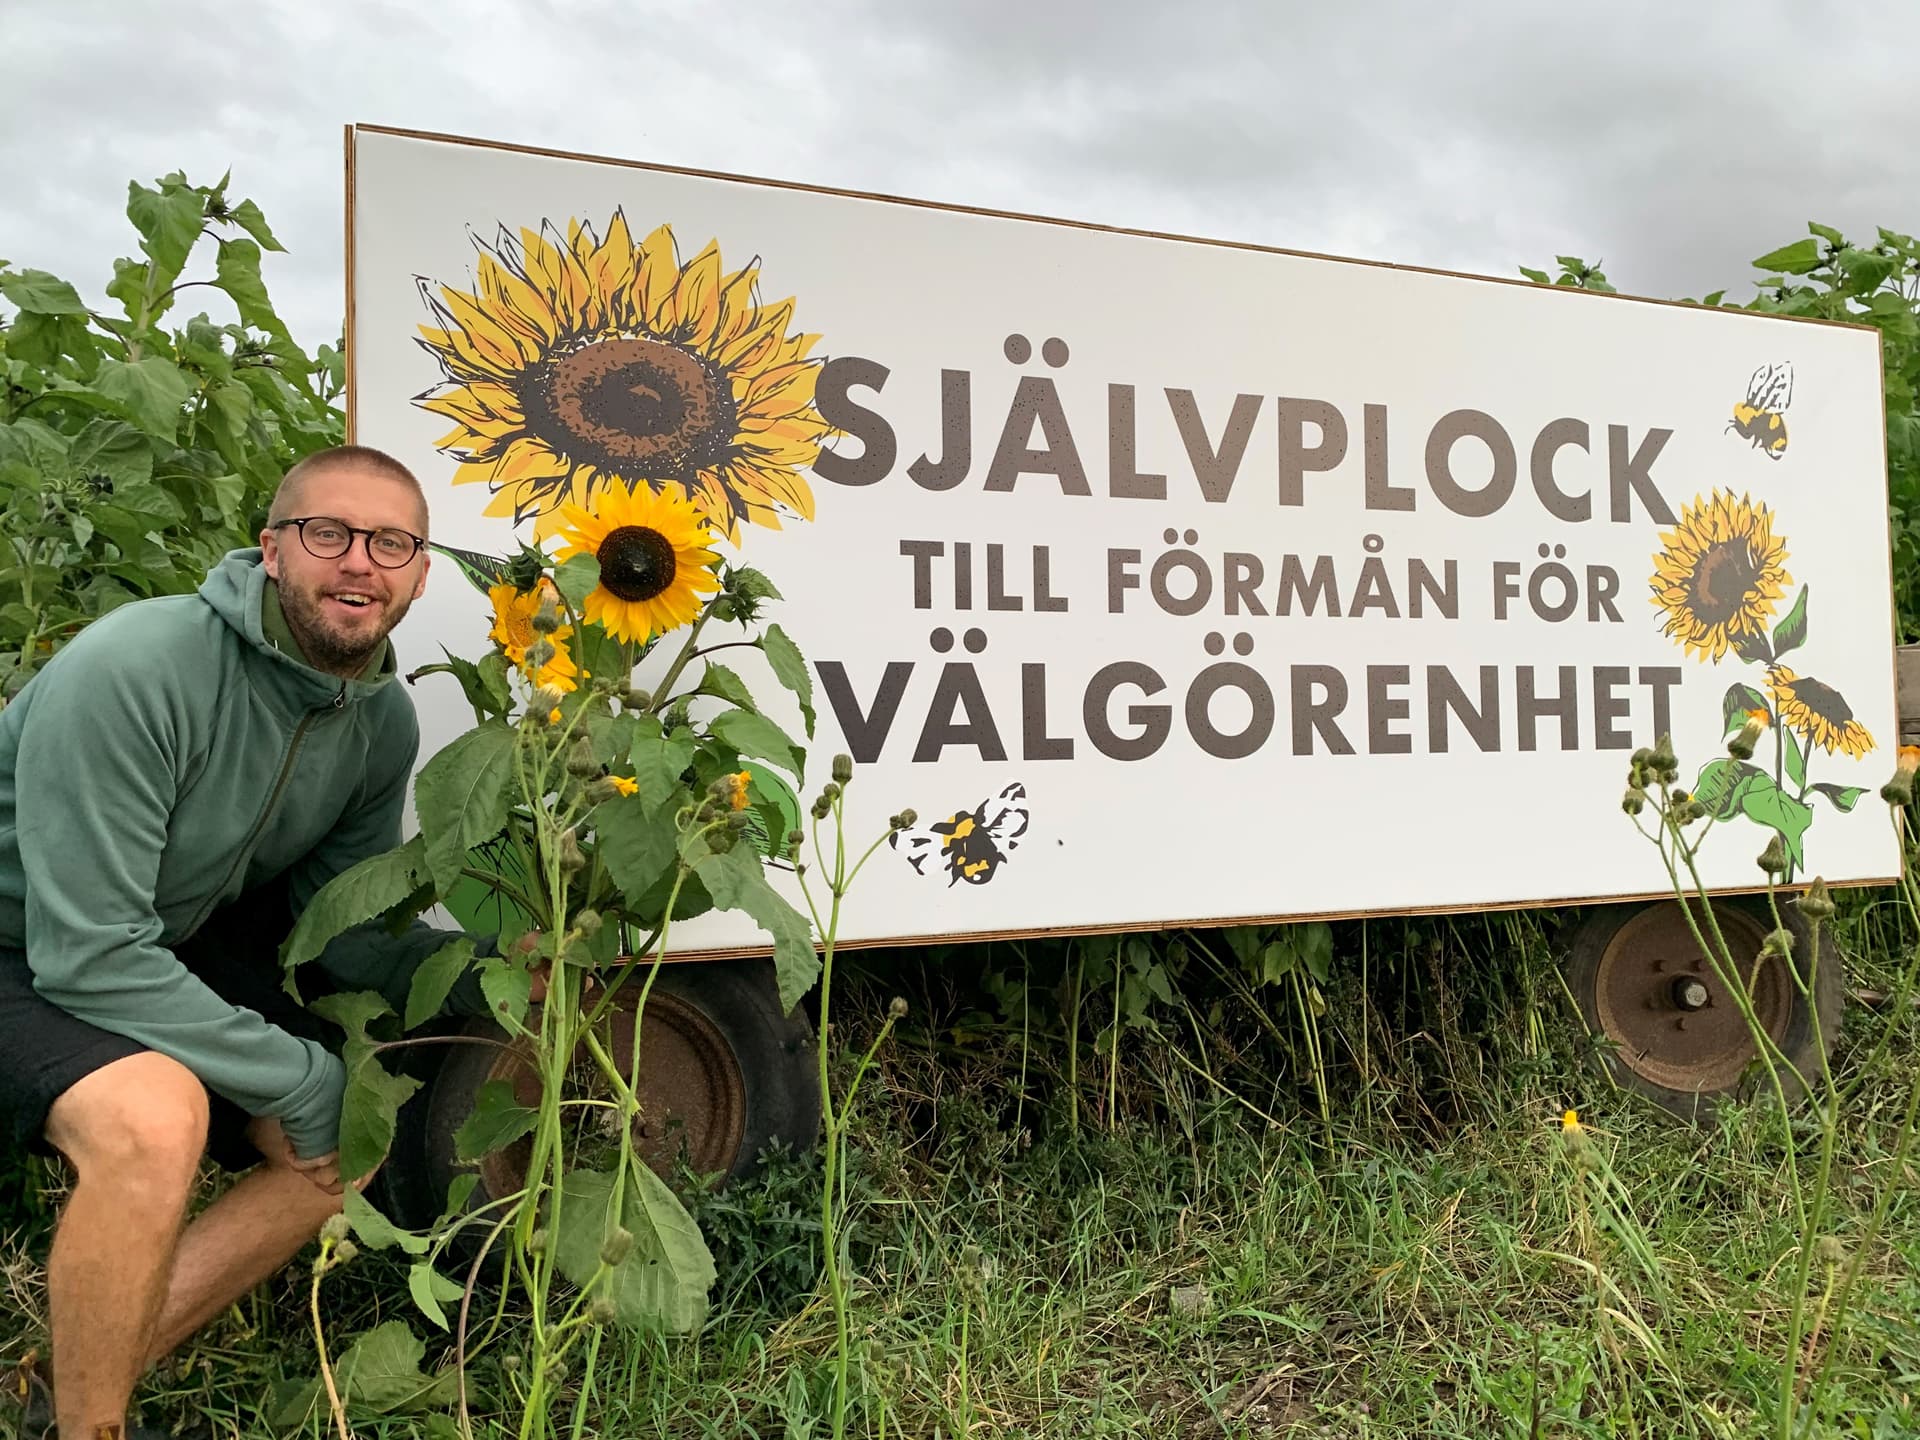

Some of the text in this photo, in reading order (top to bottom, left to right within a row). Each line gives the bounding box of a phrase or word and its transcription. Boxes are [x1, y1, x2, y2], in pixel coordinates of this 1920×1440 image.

[811, 333, 1679, 525] SJÄLVPLOCK
[899, 527, 1624, 623] TILL FÖRMÅN FÖR
[813, 627, 1682, 764] VÄLGÖRENHET
